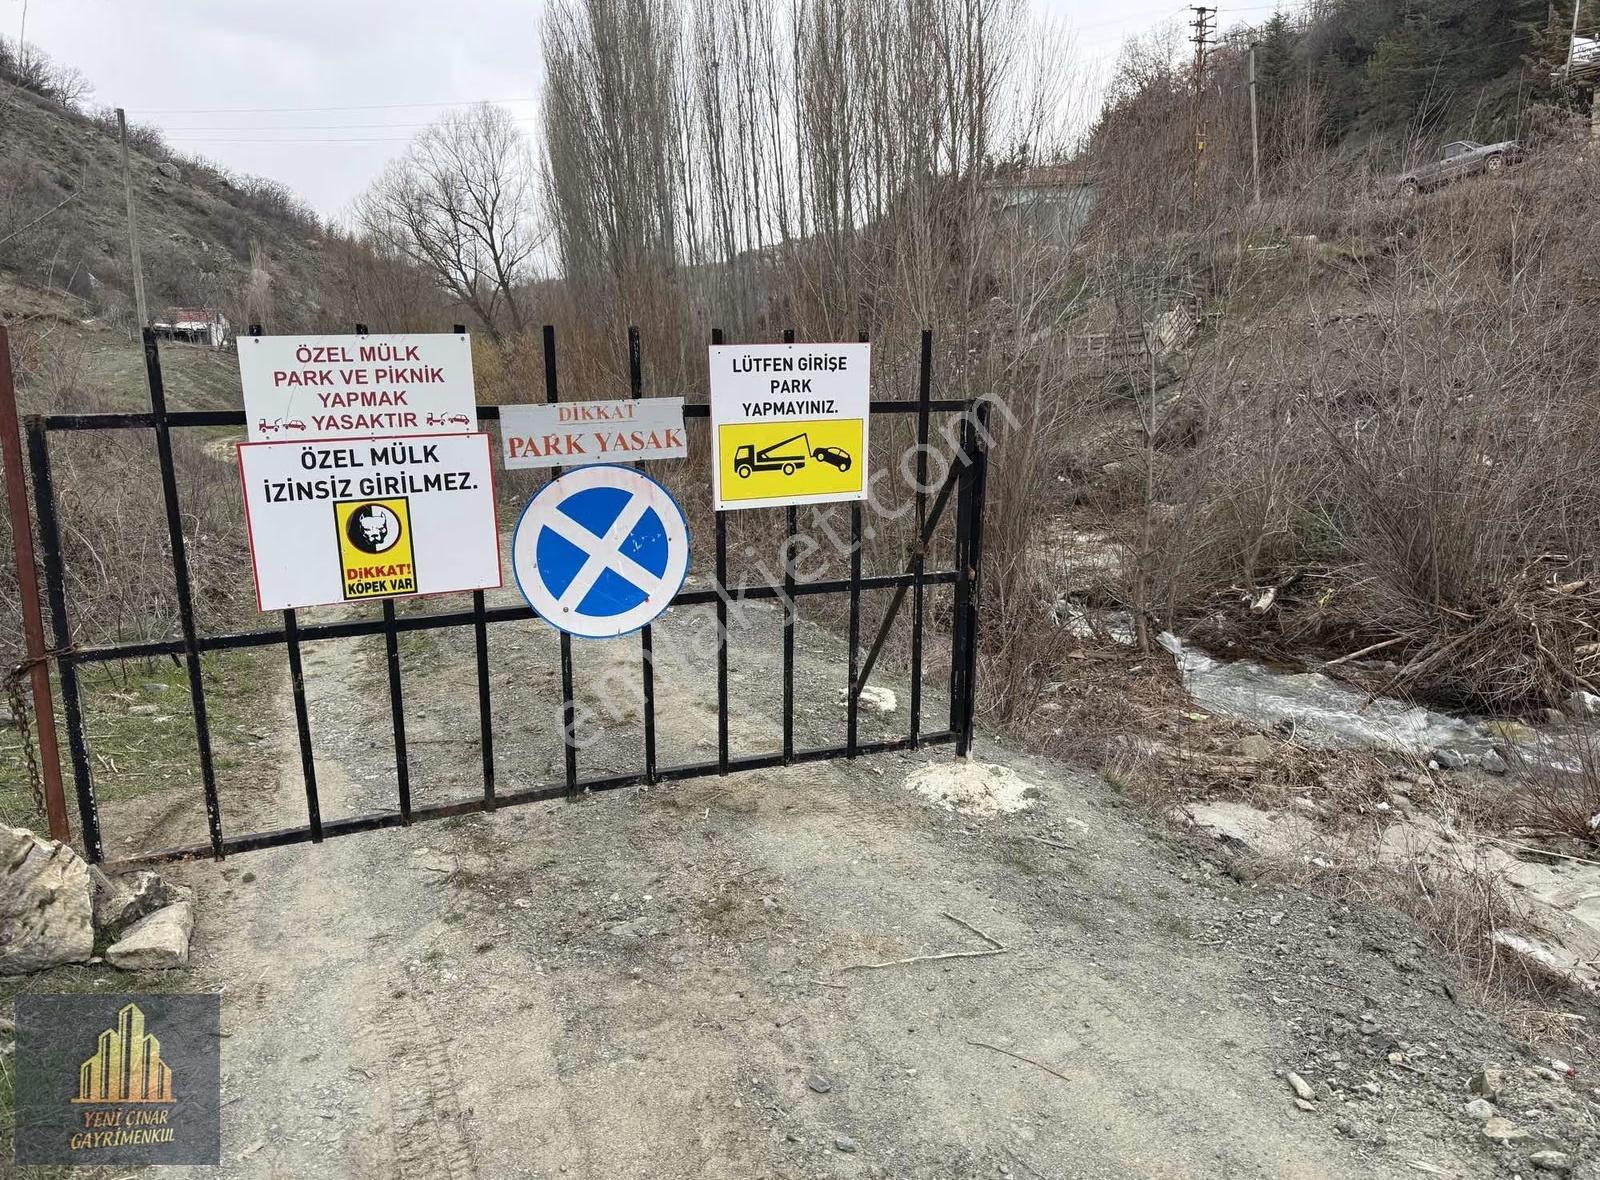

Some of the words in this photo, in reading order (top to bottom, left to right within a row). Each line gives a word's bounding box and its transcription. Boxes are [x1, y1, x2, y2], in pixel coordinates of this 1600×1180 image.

[296, 344, 354, 363] ÖZEL
[360, 343, 420, 362] MÜLK
[733, 355, 793, 373] LÜTFEN
[798, 353, 847, 372] GİRİŞE
[274, 370, 335, 387] PARK
[340, 369, 369, 385] VE
[375, 365, 445, 384] PİKNİK
[770, 379, 812, 394] PARK
[317, 390, 408, 408] YAPMAK
[742, 400, 838, 417] YAPMAYINIZ.
[311, 412, 418, 431] YASAKTIR
[558, 402, 636, 422] DİKKAT
[508, 433, 586, 458] PARK
[594, 428, 683, 452] YASAK
[301, 446, 363, 470] ÖZEL
[371, 442, 440, 466] MÜLK
[264, 475, 352, 502] İZİNSİZ
[359, 471, 478, 496] GİRİLMEZ.
[348, 579, 387, 595] KÖPEK
[390, 578, 413, 590] VAR
